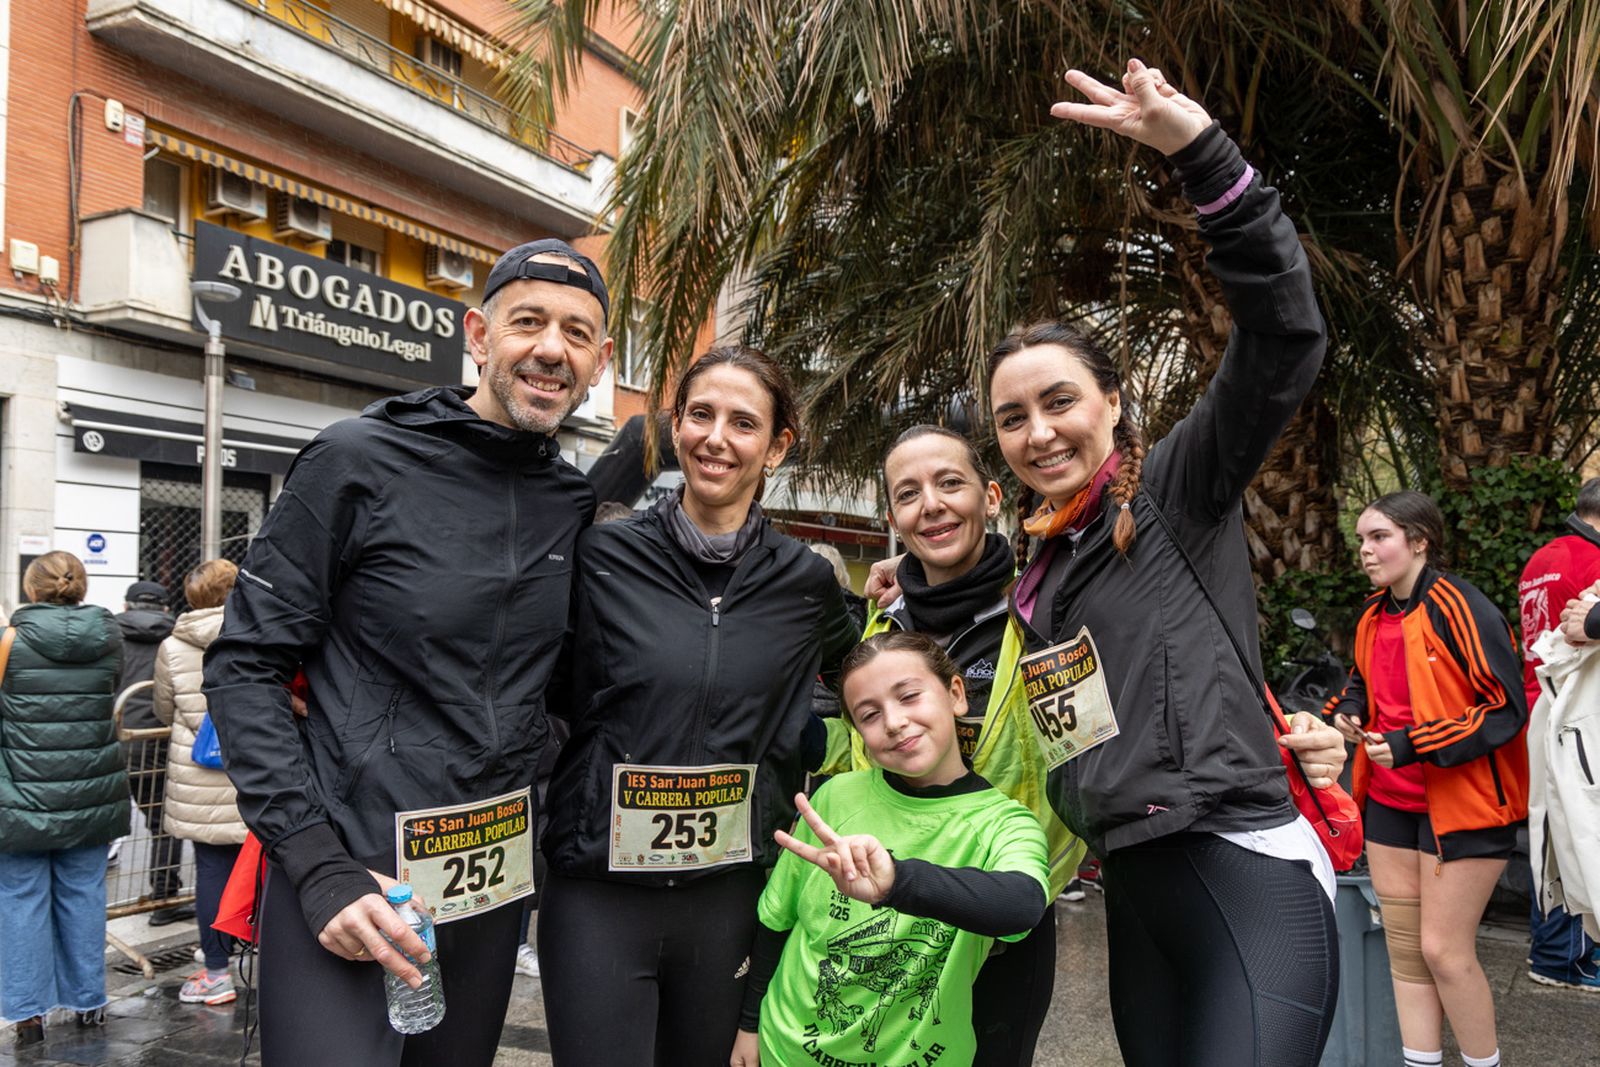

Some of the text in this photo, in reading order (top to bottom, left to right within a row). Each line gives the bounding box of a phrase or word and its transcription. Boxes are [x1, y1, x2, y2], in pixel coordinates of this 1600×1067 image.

[218, 244, 455, 338] ABOGADOS
[1027, 658, 1055, 679] Juan
[1057, 642, 1089, 666] Bosco
[1046, 656, 1095, 690] POPULAR
[1030, 690, 1078, 743] 455
[624, 787, 744, 807] V CARRERA POPULAR
[627, 773, 741, 789] IES San Juan Bosco
[410, 815, 526, 857] V CARRERA POPULAR
[413, 800, 524, 837] IES San Juan Bosco
[650, 811, 718, 850] 253
[443, 846, 506, 899] 252
